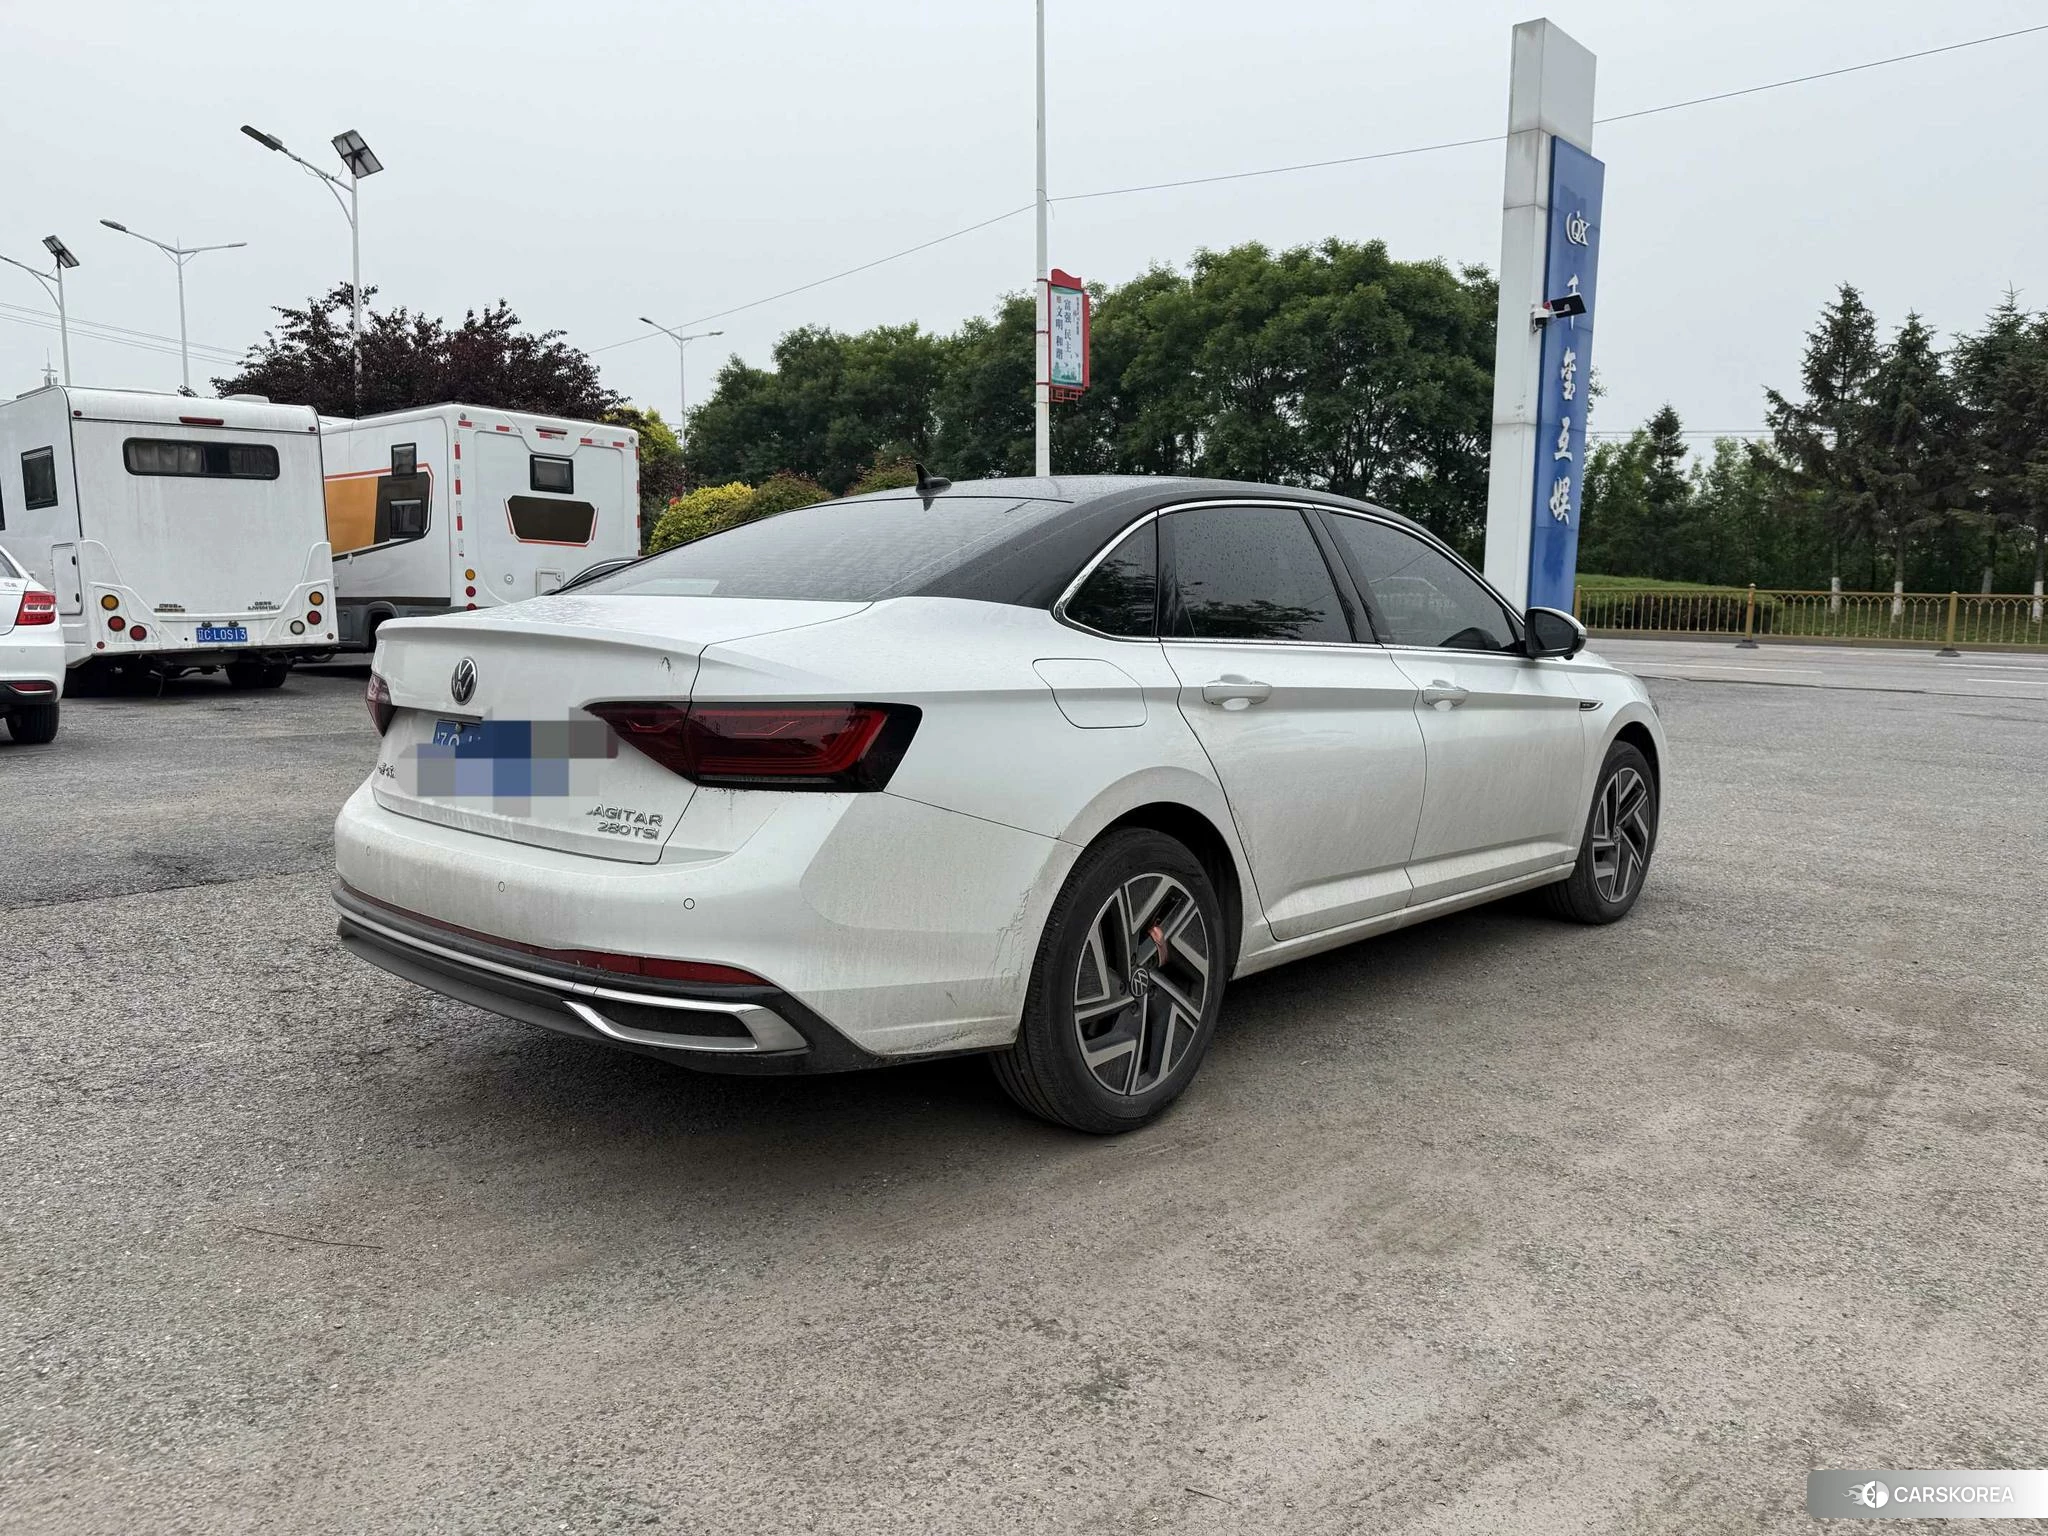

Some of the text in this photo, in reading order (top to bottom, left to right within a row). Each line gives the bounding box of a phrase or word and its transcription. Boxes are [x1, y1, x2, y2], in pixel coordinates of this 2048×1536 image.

[1056, 306, 1063, 330] 文明
[1064, 329, 1071, 352] 民主
[585, 803, 664, 827] AGITAR
[597, 820, 660, 841] 280TSI
